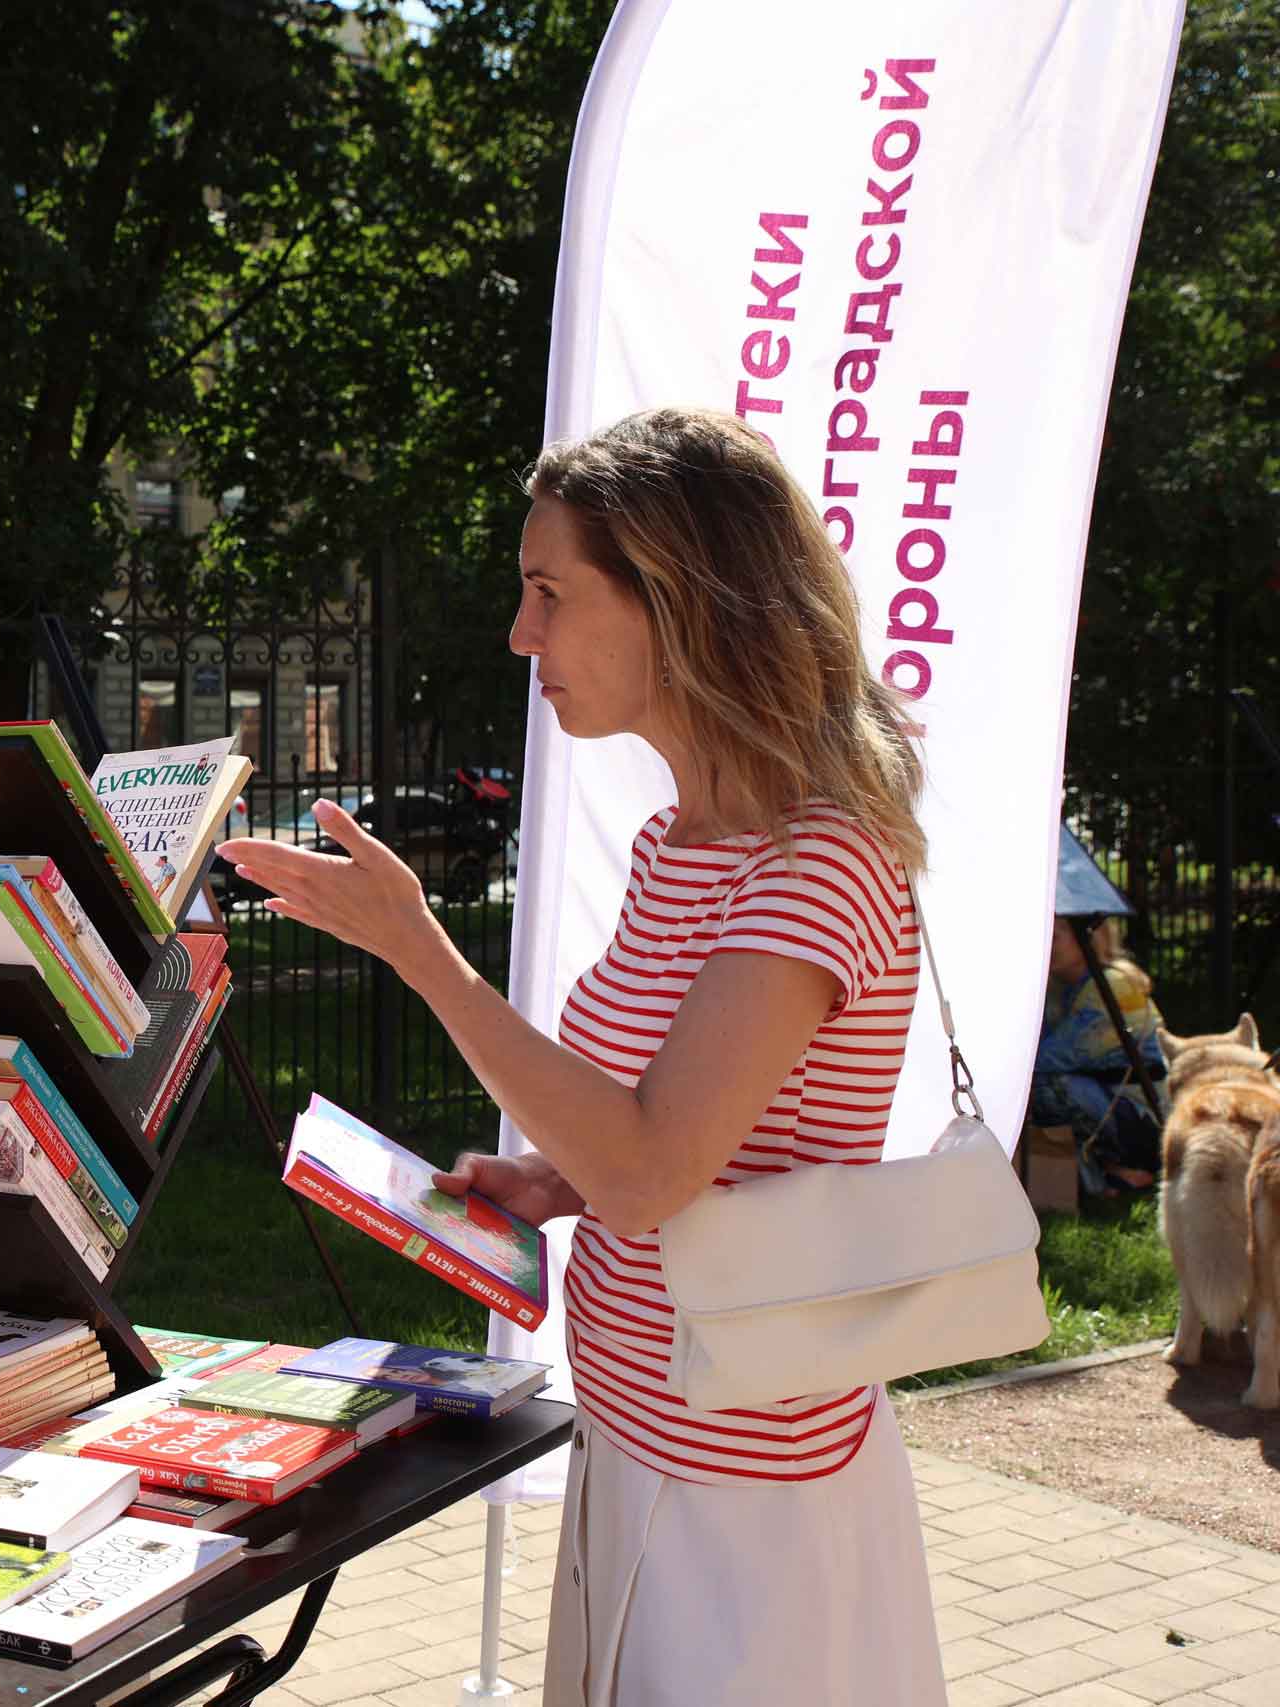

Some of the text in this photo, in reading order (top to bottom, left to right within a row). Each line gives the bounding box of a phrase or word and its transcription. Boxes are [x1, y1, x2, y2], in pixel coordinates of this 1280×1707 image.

[96, 762, 218, 796] EVERYTHING
[114, 809, 197, 829] БУЧЕНИЕ
[123, 830, 176, 853] БАК
[426, 1252, 457, 1274] ЛЕТО
[467, 1277, 512, 1309] ЧТЕНИЕ
[98, 1419, 173, 1450] Как
[158, 1472, 180, 1486] Как
